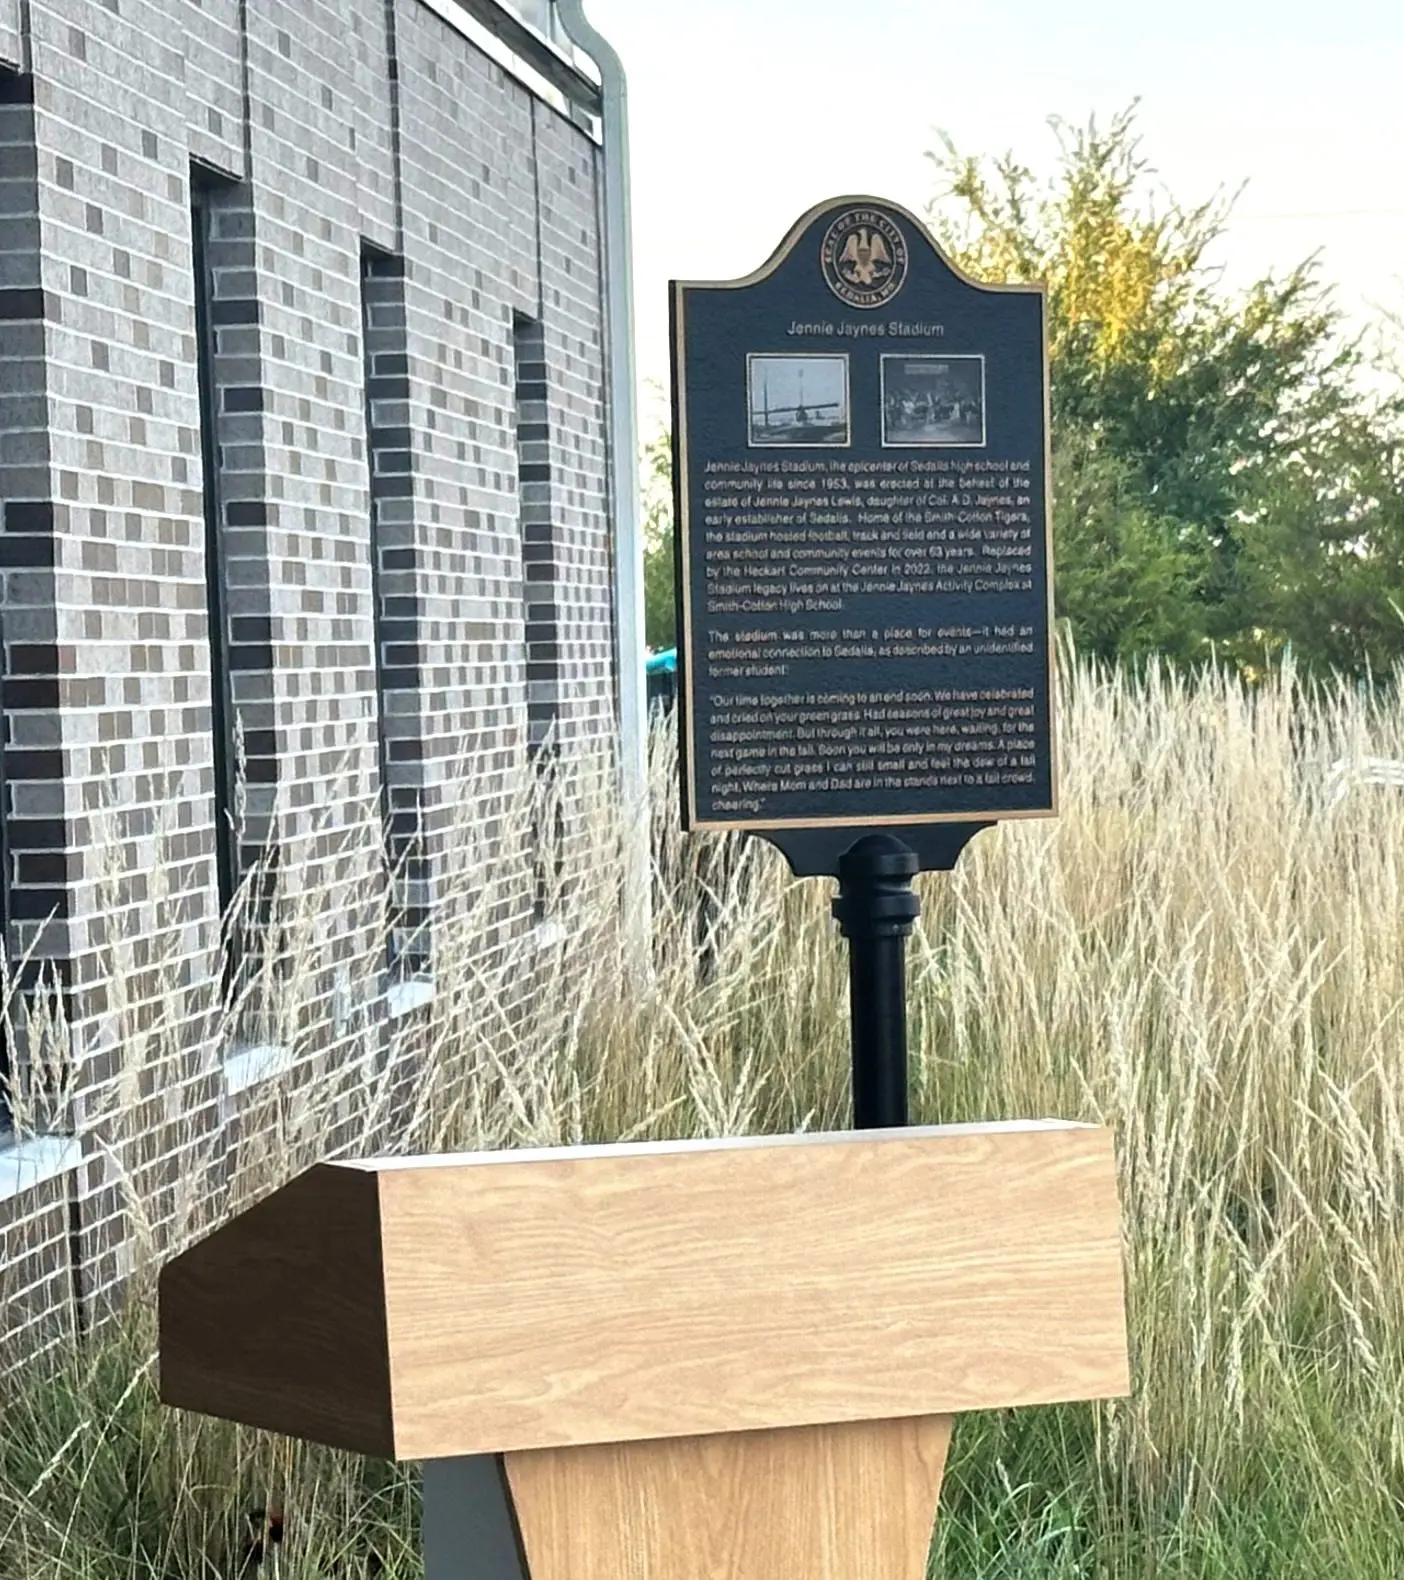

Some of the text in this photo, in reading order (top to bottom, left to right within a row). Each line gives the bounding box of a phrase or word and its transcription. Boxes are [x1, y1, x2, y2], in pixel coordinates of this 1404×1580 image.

[855, 213, 876, 222] THE
[879, 219, 900, 242] CITY
[787, 320, 944, 338] Jennie Jaynes Stadium
[704, 460, 741, 472] Jennie
[741, 460, 779, 475] Jaynes
[829, 460, 847, 472] the
[848, 460, 897, 474] epicenter
[910, 460, 949, 471] Sedalia
[950, 460, 973, 474] high
[974, 460, 1008, 471] school
[1010, 460, 1030, 471] and
[704, 478, 763, 492] community
[768, 478, 783, 489] life
[788, 478, 815, 489] since
[854, 480, 876, 489] was
[879, 477, 919, 489] erected
[938, 477, 954, 488] the
[959, 477, 995, 488] behest
[1013, 477, 1030, 488] the
[704, 496, 738, 507] estate
[753, 496, 789, 507] Jennie
[792, 495, 828, 510] Jaynes
[866, 495, 913, 509] daughter
[704, 513, 730, 527] early
[734, 512, 794, 524] establisher
[858, 512, 890, 524] Home
[905, 512, 922, 523] the
[706, 531, 723, 542] the
[725, 530, 768, 542] stadium
[769, 530, 806, 542] hosted
[852, 530, 878, 541] track
[880, 529, 900, 541] and
[926, 529, 946, 540] and
[957, 529, 981, 540] wide
[983, 529, 1018, 543] variety
[706, 550, 730, 559] area
[733, 548, 768, 559] school
[770, 547, 790, 559] and
[792, 547, 849, 561] community
[851, 546, 886, 558] events
[888, 546, 901, 558] for
[904, 548, 927, 557] over
[982, 544, 1031, 559] Replaced
[706, 565, 721, 579] by
[723, 565, 740, 576] the
[744, 564, 786, 576] Heckart
[788, 564, 849, 579] Community
[851, 564, 887, 575] Center
[937, 564, 953, 574] the
[957, 563, 992, 574] Jennie
[995, 563, 1032, 577] Jaynes
[707, 579, 1020, 596] Stadium legacy lives the Jennie Jaynes Activity Complex
[707, 599, 804, 613] Smith-Cotton High
[708, 625, 1014, 642] The stadium was more than place for had
[708, 647, 760, 659] emotional
[762, 646, 821, 658] connection
[892, 643, 943, 656] described
[708, 665, 743, 676] former
[735, 693, 758, 706] time
[760, 692, 804, 708] together
[817, 691, 855, 707] coming
[884, 690, 903, 702] end
[952, 689, 977, 701] have
[979, 688, 1034, 701] celebrated
[710, 712, 730, 723] and
[731, 711, 758, 723] cried
[774, 712, 798, 725] your
[799, 712, 829, 724] green
[863, 708, 885, 720] Had
[887, 709, 930, 719] seasons
[942, 706, 970, 721] great
[987, 705, 1006, 717] and
[1007, 704, 1034, 720] great
[796, 727, 816, 739] But
[816, 726, 857, 741] through
[885, 727, 904, 739] you
[906, 726, 931, 736] were
[1002, 721, 1017, 733] for
[1018, 721, 1034, 733] the
[710, 746, 734, 758] next
[736, 748, 765, 760] game
[778, 745, 796, 756] the
[818, 743, 846, 755] Soon
[848, 745, 866, 757] you
[868, 742, 886, 754] will
[902, 741, 924, 756] only
[1007, 738, 1035, 753] place
[724, 763, 771, 778] perfectly
[774, 762, 792, 774] cut
[794, 763, 823, 776] grass
[833, 762, 852, 772] can
[856, 760, 874, 771] still
[908, 758, 928, 770] and
[953, 757, 971, 768] the
[742, 779, 778, 791] Where
[780, 778, 807, 790] Mom
[808, 777, 829, 789] and
[830, 777, 852, 789] Dad
[854, 778, 871, 788] are
[884, 775, 902, 787] the
[903, 774, 938, 787] stands
[940, 774, 962, 785] next
